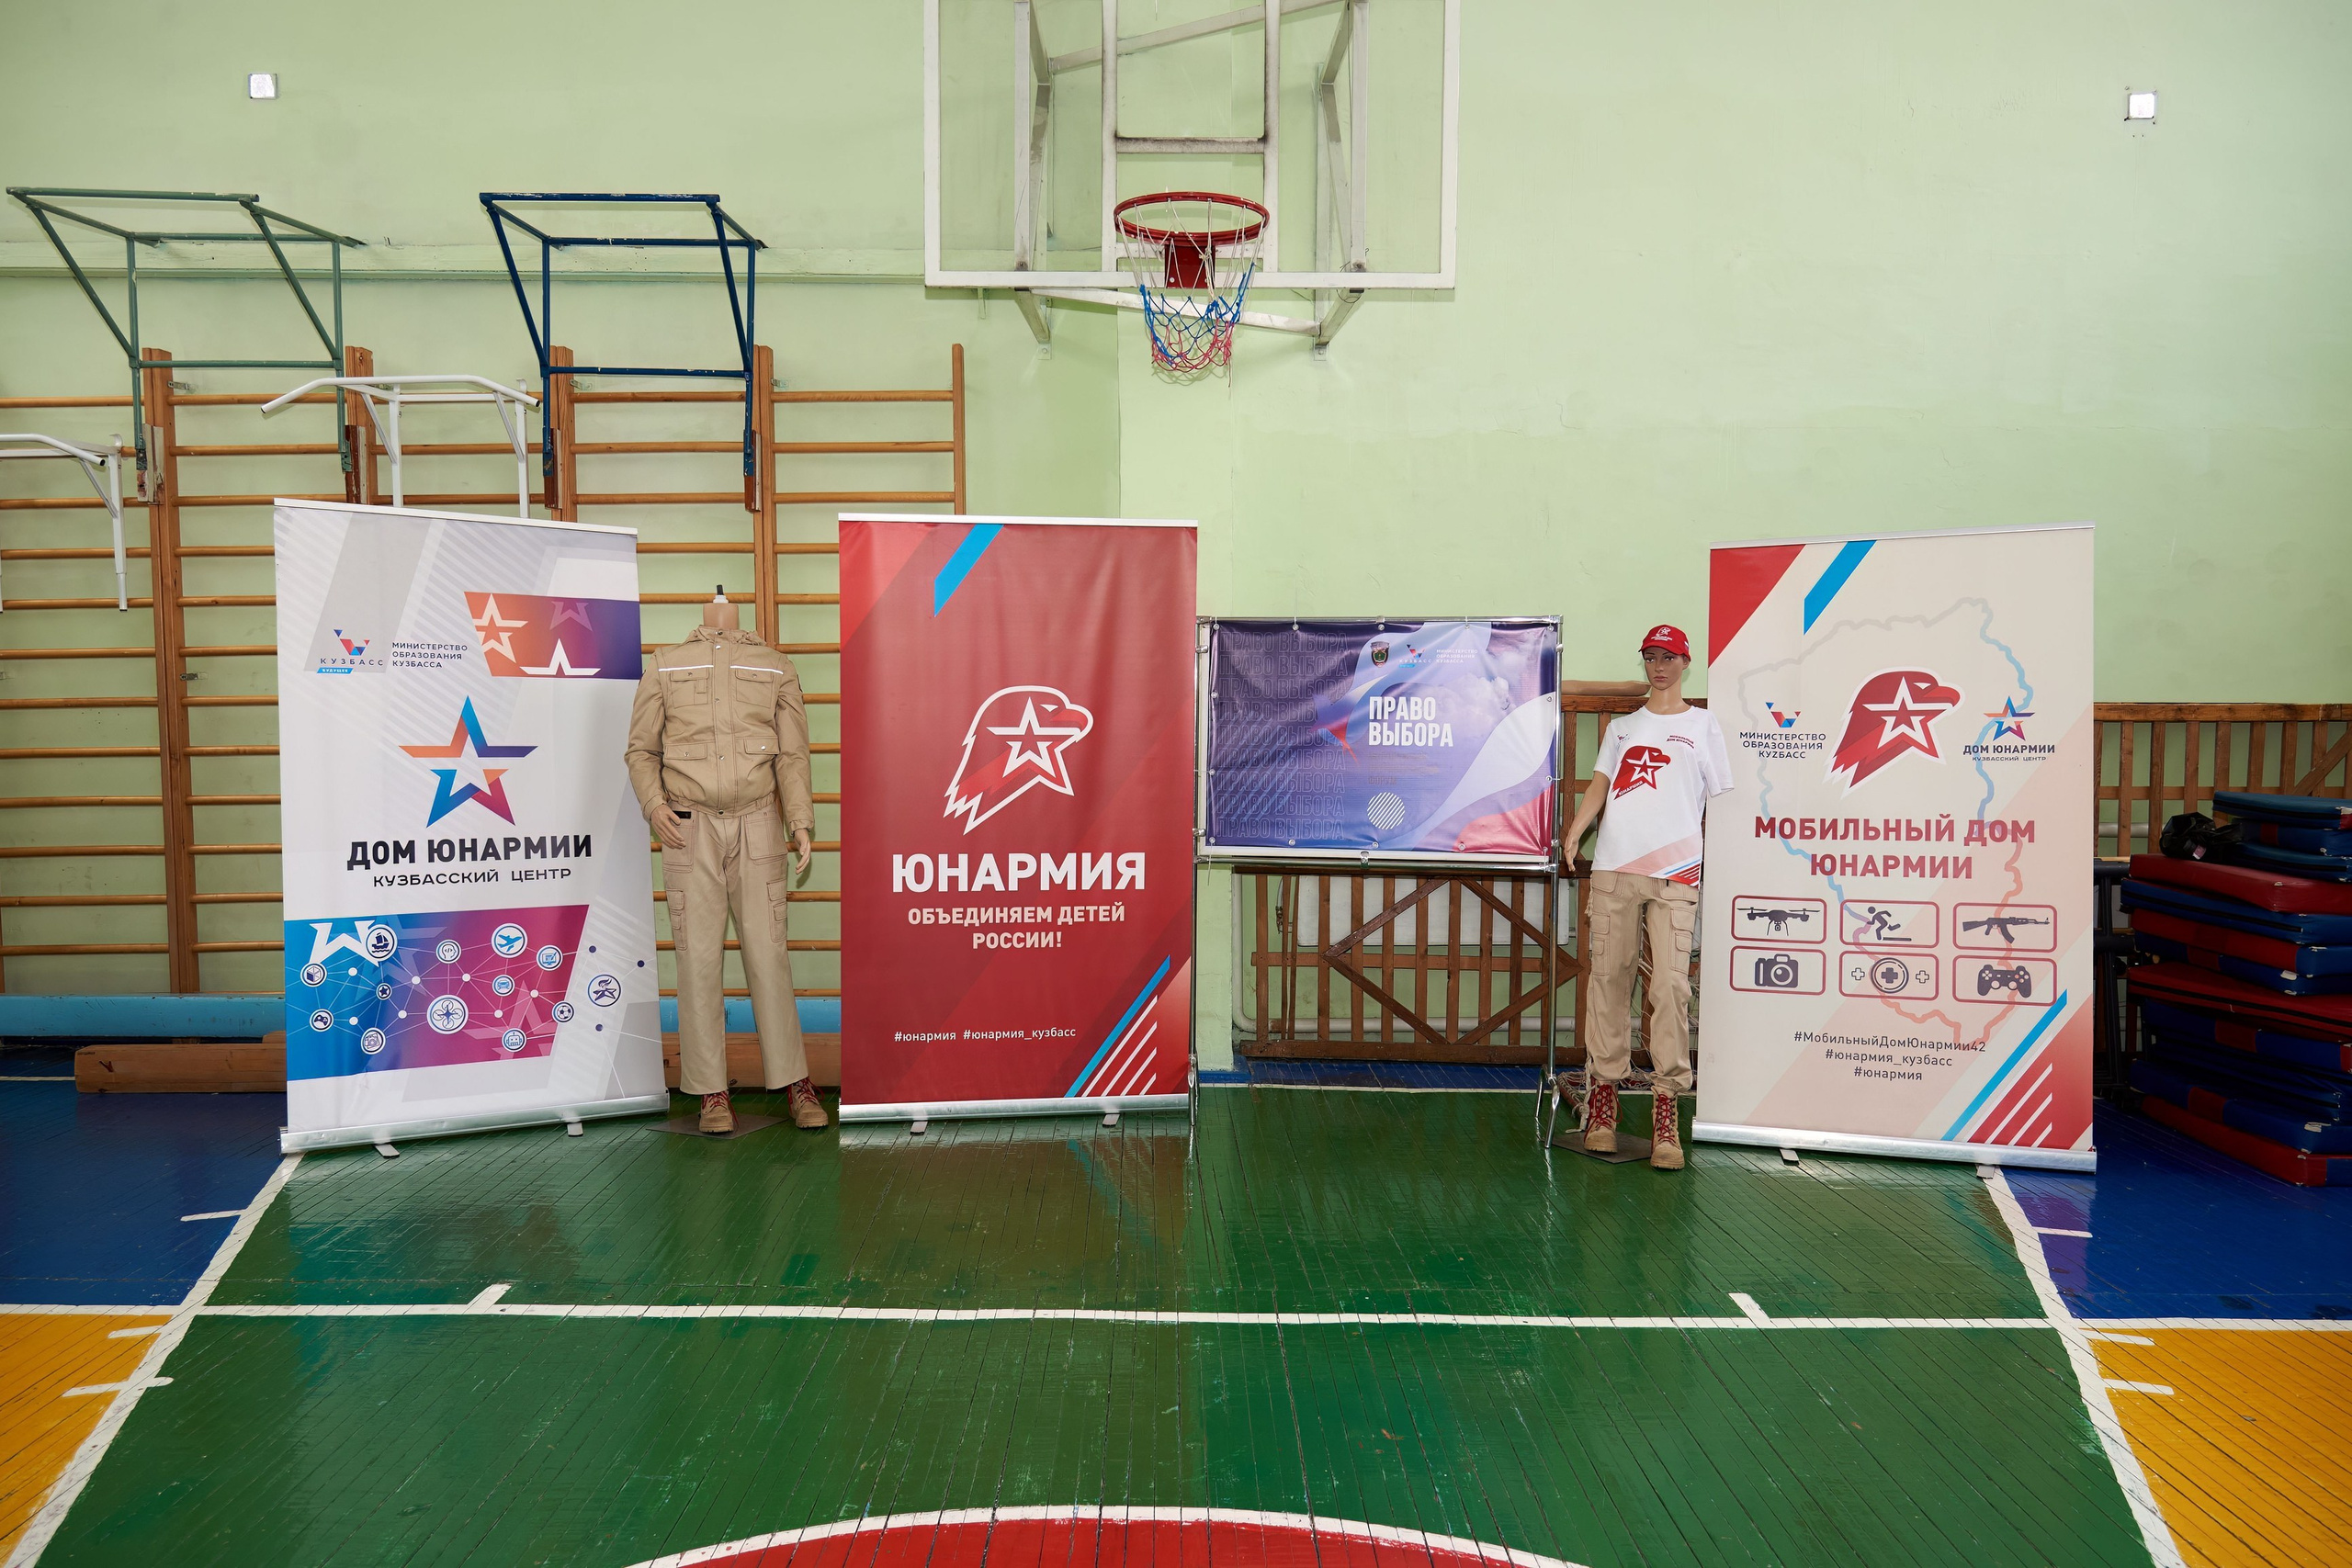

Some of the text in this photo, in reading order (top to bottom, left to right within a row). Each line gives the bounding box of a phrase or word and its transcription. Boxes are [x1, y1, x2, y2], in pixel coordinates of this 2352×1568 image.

[392, 642, 468, 651] МИНИСТЕРСТВО
[1220, 632, 1349, 653] ПРАВО ВЫБОРА
[320, 658, 384, 666] КУЗБАСС
[392, 651, 462, 660] ОБРАЗОВАНИЯ
[392, 660, 443, 669] КУЗБАССА
[1219, 655, 1348, 676] ПРАВО ВЫБОРА
[1219, 678, 1273, 698] ПРАВО
[1219, 701, 1317, 722] ПРАВО ВЫБ
[1369, 696, 1436, 721] ПРАВО
[1217, 725, 1272, 745] ПРАВО
[1369, 722, 1453, 747] ВЫБОРА
[1739, 732, 1826, 741] МИНИСТЕРСТВО
[1743, 740, 1823, 750] ОБРАЗОВАНИЯ
[1217, 748, 1272, 769] ПРАВО
[1276, 749, 1346, 770] ВЫБОРА
[1962, 744, 2055, 755] ДОМ ЮНАРМИИ
[1216, 770, 1345, 793] ПРАВО ВЫБОРА
[1216, 794, 1345, 816] ПРАВО ВЫБОРА
[1216, 817, 1344, 840] ПРАВО ВЫБОРА
[1754, 813, 2036, 847] МОБИЛЬНЫЙ ДОМ
[346, 834, 593, 871] ДОМ ЮНАРМИИ
[892, 852, 1147, 893] ЮНАРМИЯ
[1810, 852, 1973, 879] ЮНАРМИИ
[373, 868, 572, 887] КУЗБАССКИЙ ЦЕНТР
[908, 901, 1125, 927] ОБЪЕДИНЯЕМ ДЕТЕЙ
[972, 931, 1063, 950] РОССИИ!
[894, 1027, 1077, 1043] #юнармия #юнармия_кузбасс
[1794, 1031, 1986, 1053] #МобильныйДомЮнармии42
[1825, 1048, 1953, 1067] #юнармия_кузбасс
[1853, 1066, 1923, 1081] #юнармия
